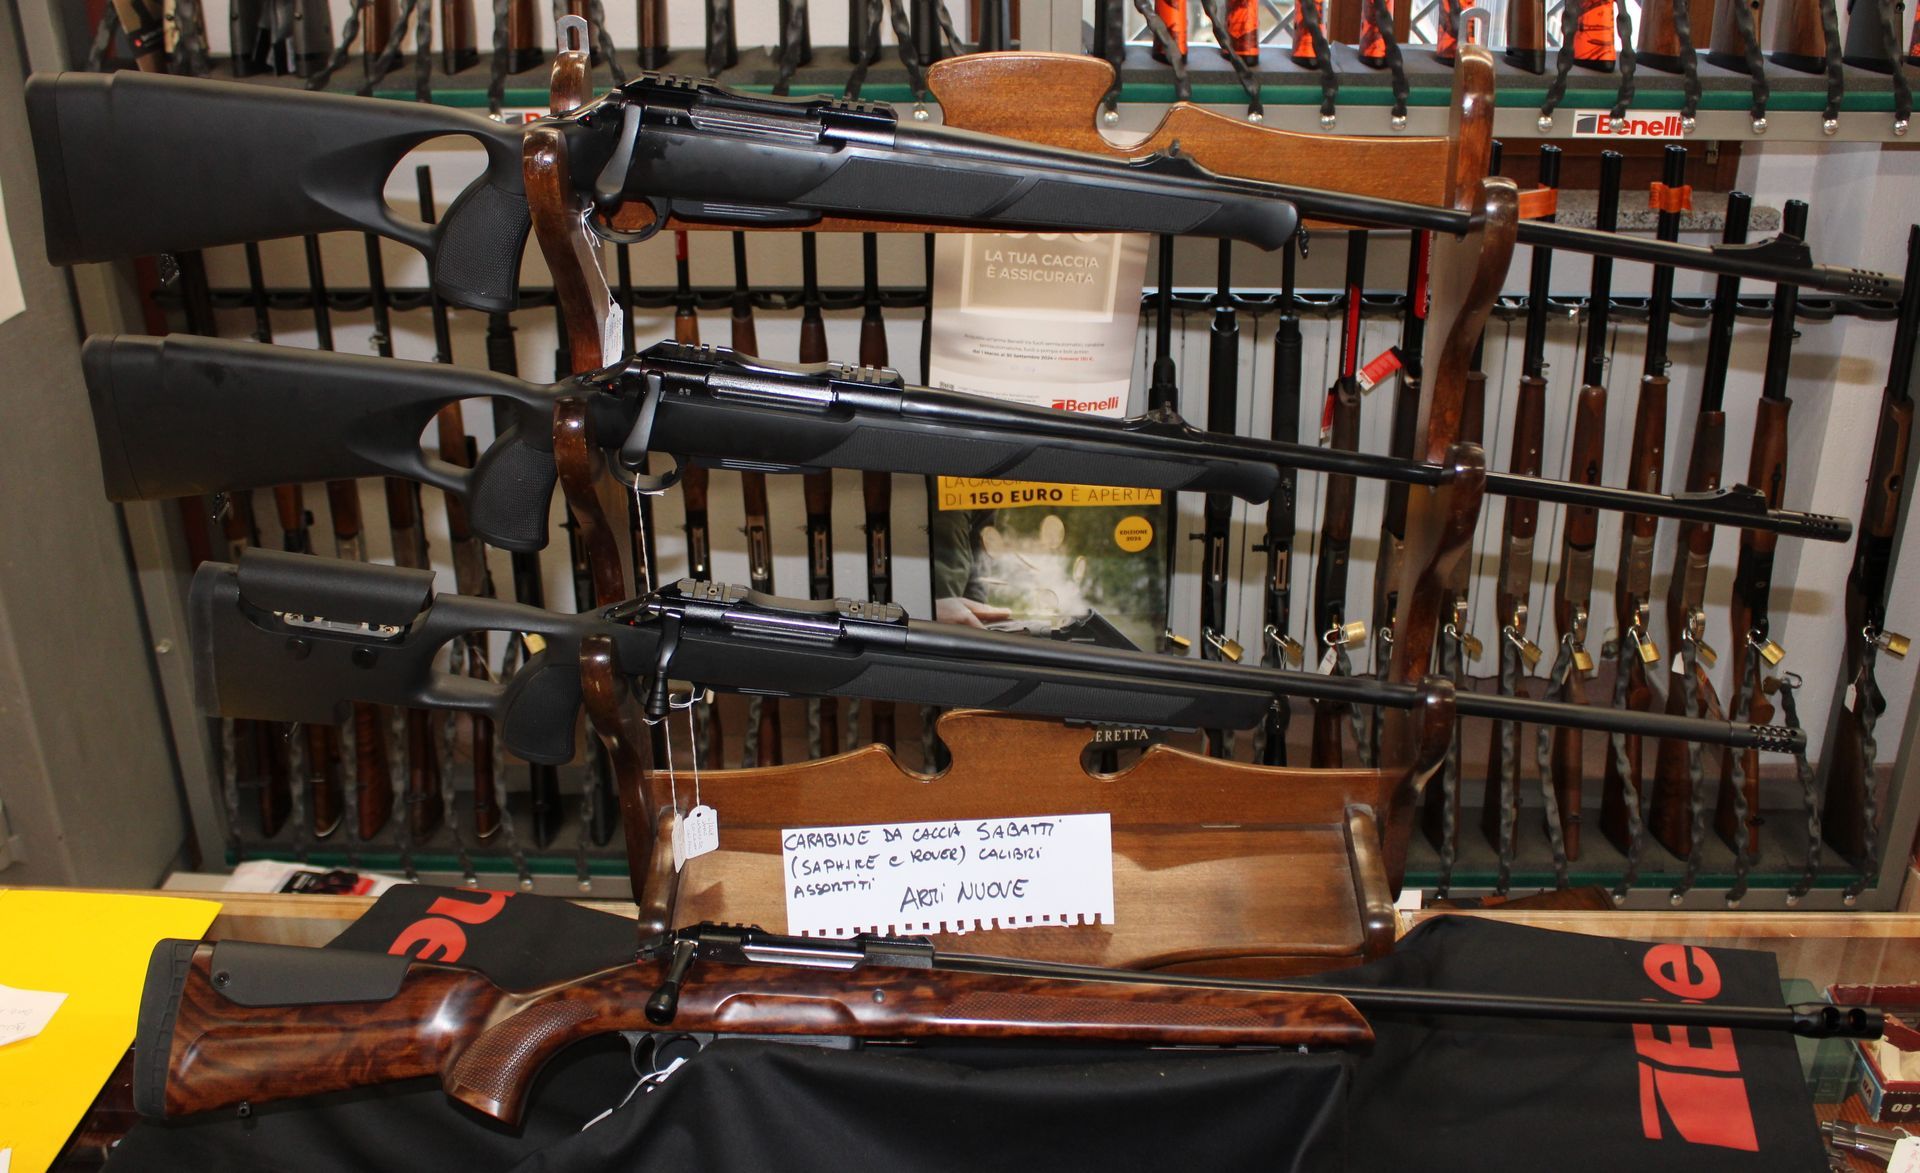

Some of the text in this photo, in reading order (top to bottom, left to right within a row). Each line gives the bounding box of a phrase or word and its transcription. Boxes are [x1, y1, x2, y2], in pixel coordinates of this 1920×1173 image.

[1596, 114, 1682, 137] Benelli
[984, 249, 1099, 269] LA TUA CACCIA
[987, 264, 1094, 285] È ASSICURATA
[1065, 396, 1120, 412] Benelli
[944, 477, 965, 488] LA
[945, 486, 1155, 506] DI 150 EURO È APERTA
[1090, 729, 1149, 743] ERETTA
[783, 818, 1063, 851] CARABINE DA CACCIA SABATTI
[791, 853, 881, 879] (SAPHIRE
[910, 845, 966, 865] ROVER)
[978, 846, 1043, 861] CALIBRI
[793, 873, 876, 899] ASSORTITI
[957, 878, 1029, 904] NUOVE
